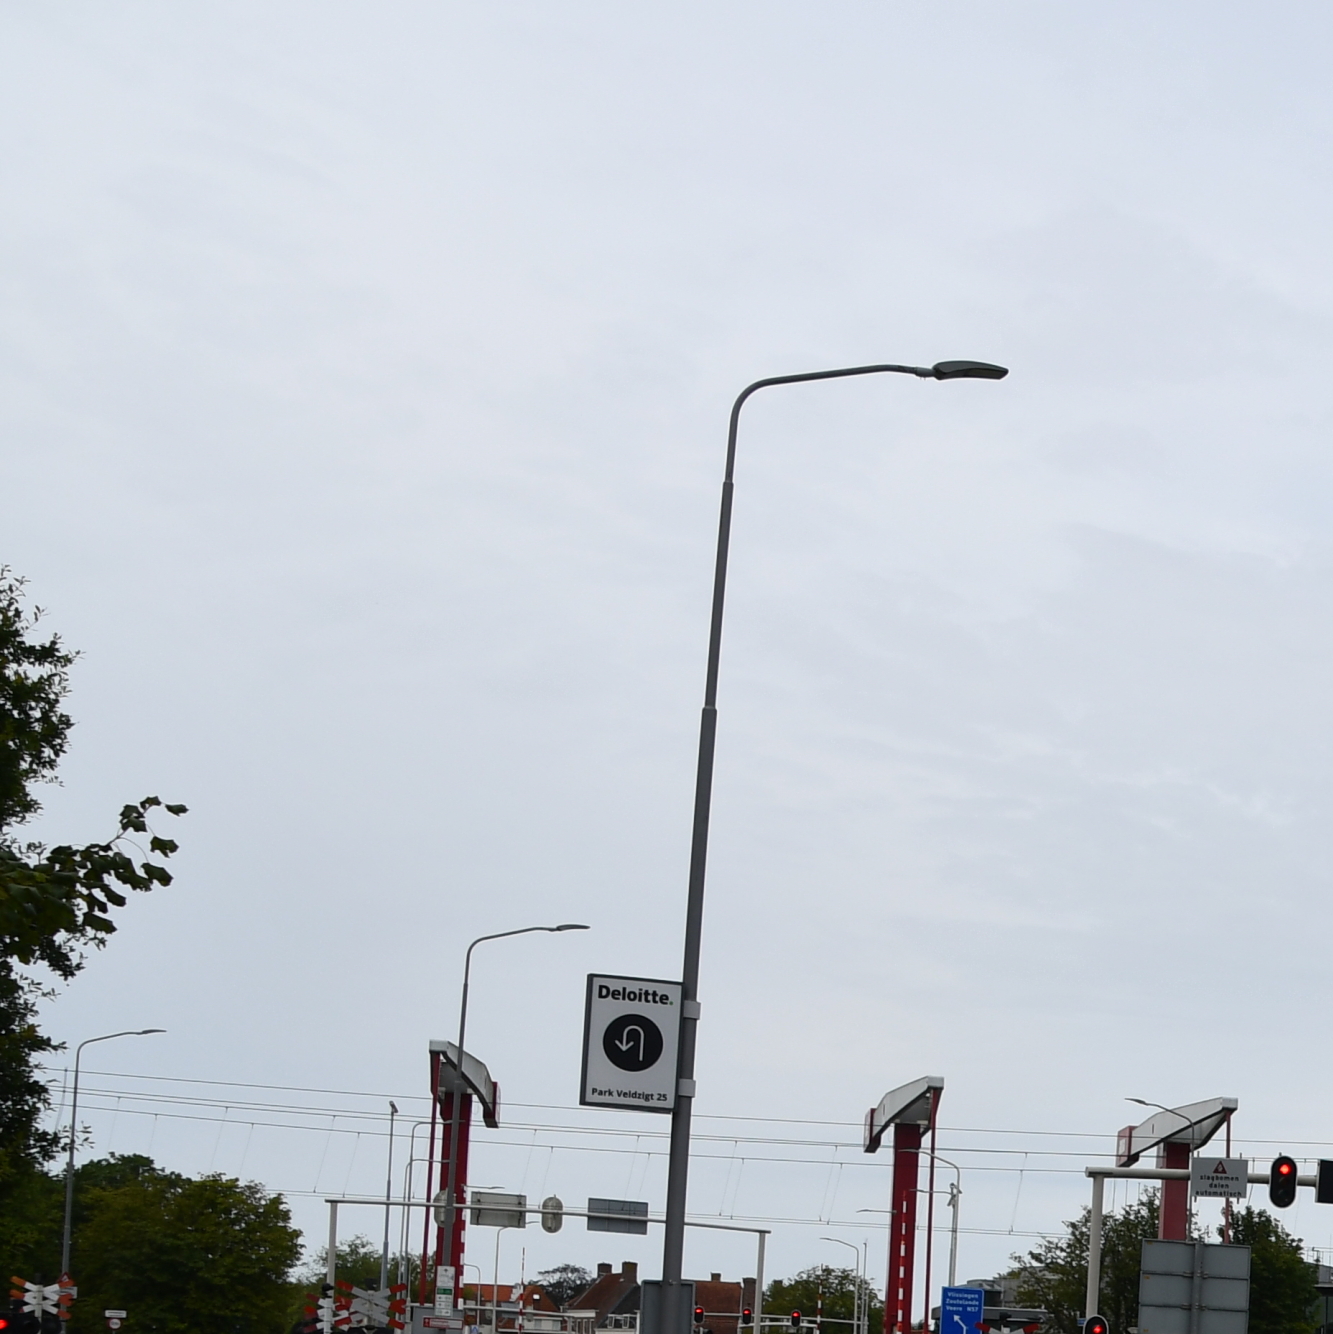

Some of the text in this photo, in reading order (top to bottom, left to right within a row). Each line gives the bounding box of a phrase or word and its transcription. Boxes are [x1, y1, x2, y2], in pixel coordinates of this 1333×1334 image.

[597, 984, 674, 1006] Deloitte.
[591, 1087, 668, 1102] Park Veldzigt 25
[1199, 1174, 1240, 1182] slagbomen
[947, 1291, 979, 1299] Vlissingen
